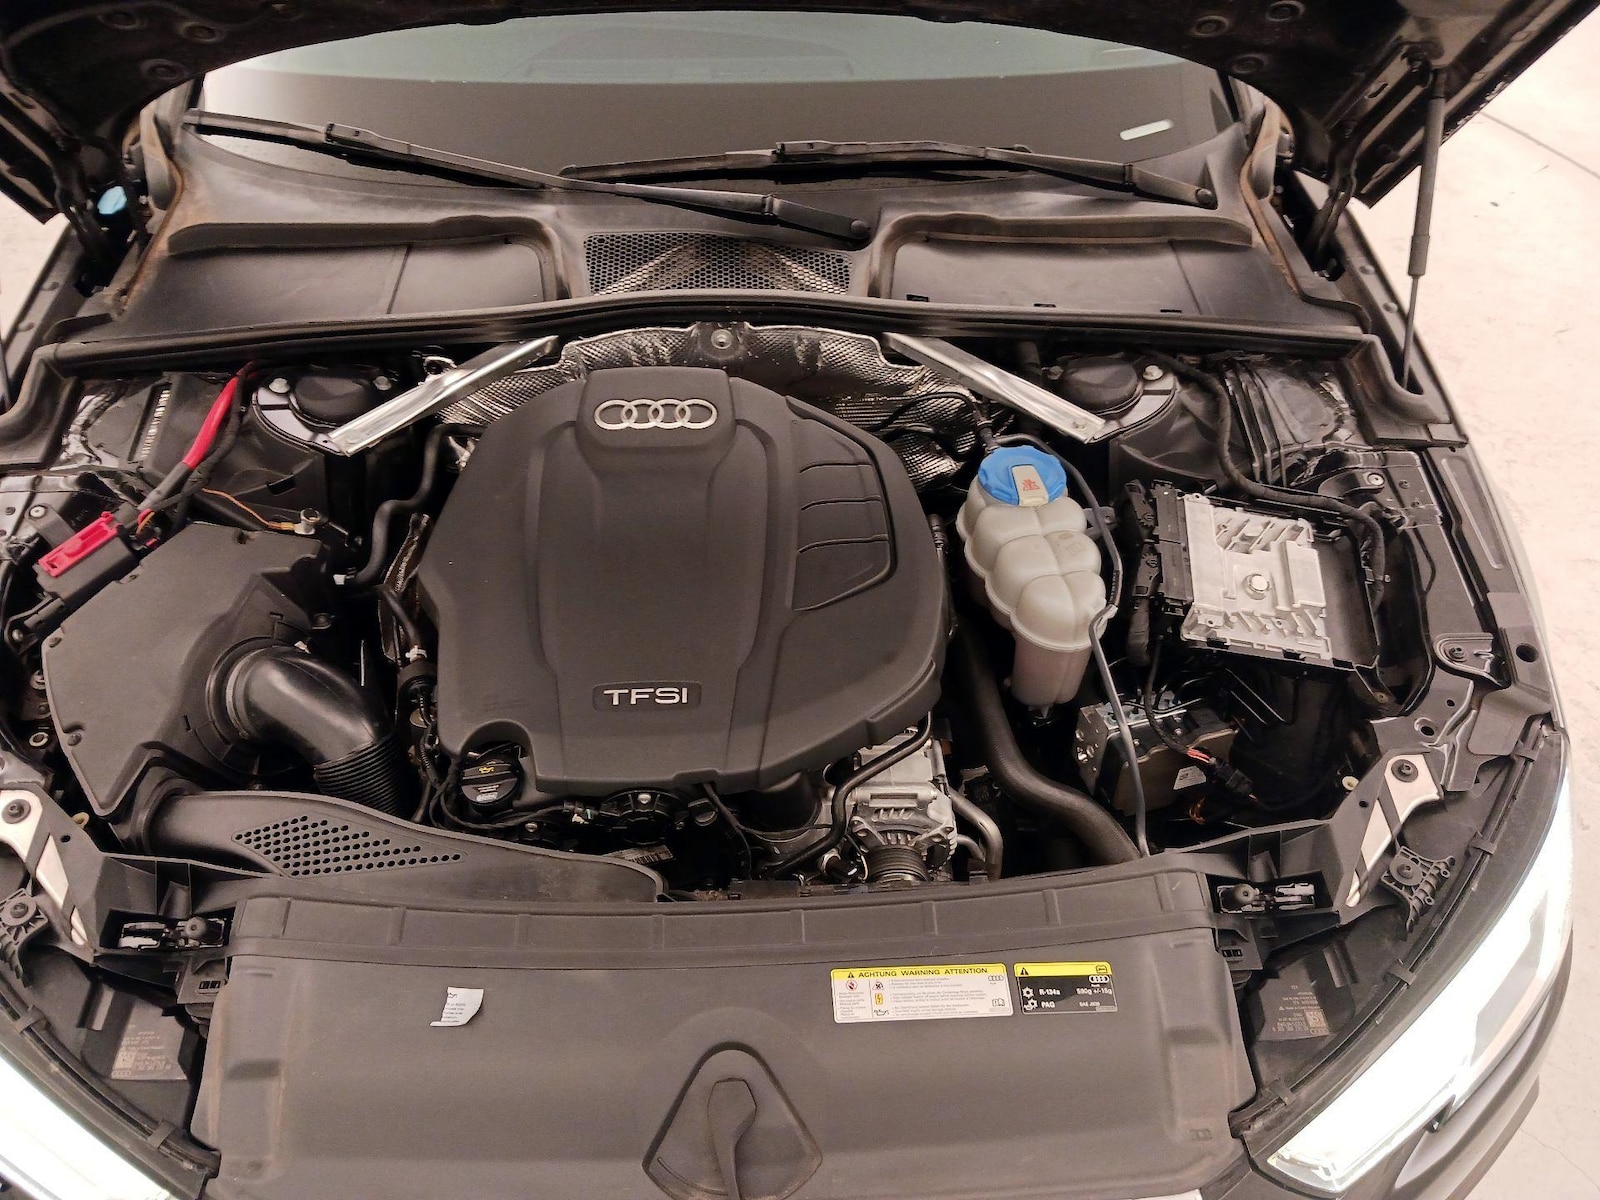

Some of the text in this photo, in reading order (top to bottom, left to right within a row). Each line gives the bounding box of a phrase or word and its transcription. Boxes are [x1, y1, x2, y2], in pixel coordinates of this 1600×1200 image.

[603, 687, 688, 706] TFSI
[858, 967, 988, 978] ACHTUNG WARNING ATTENTION
